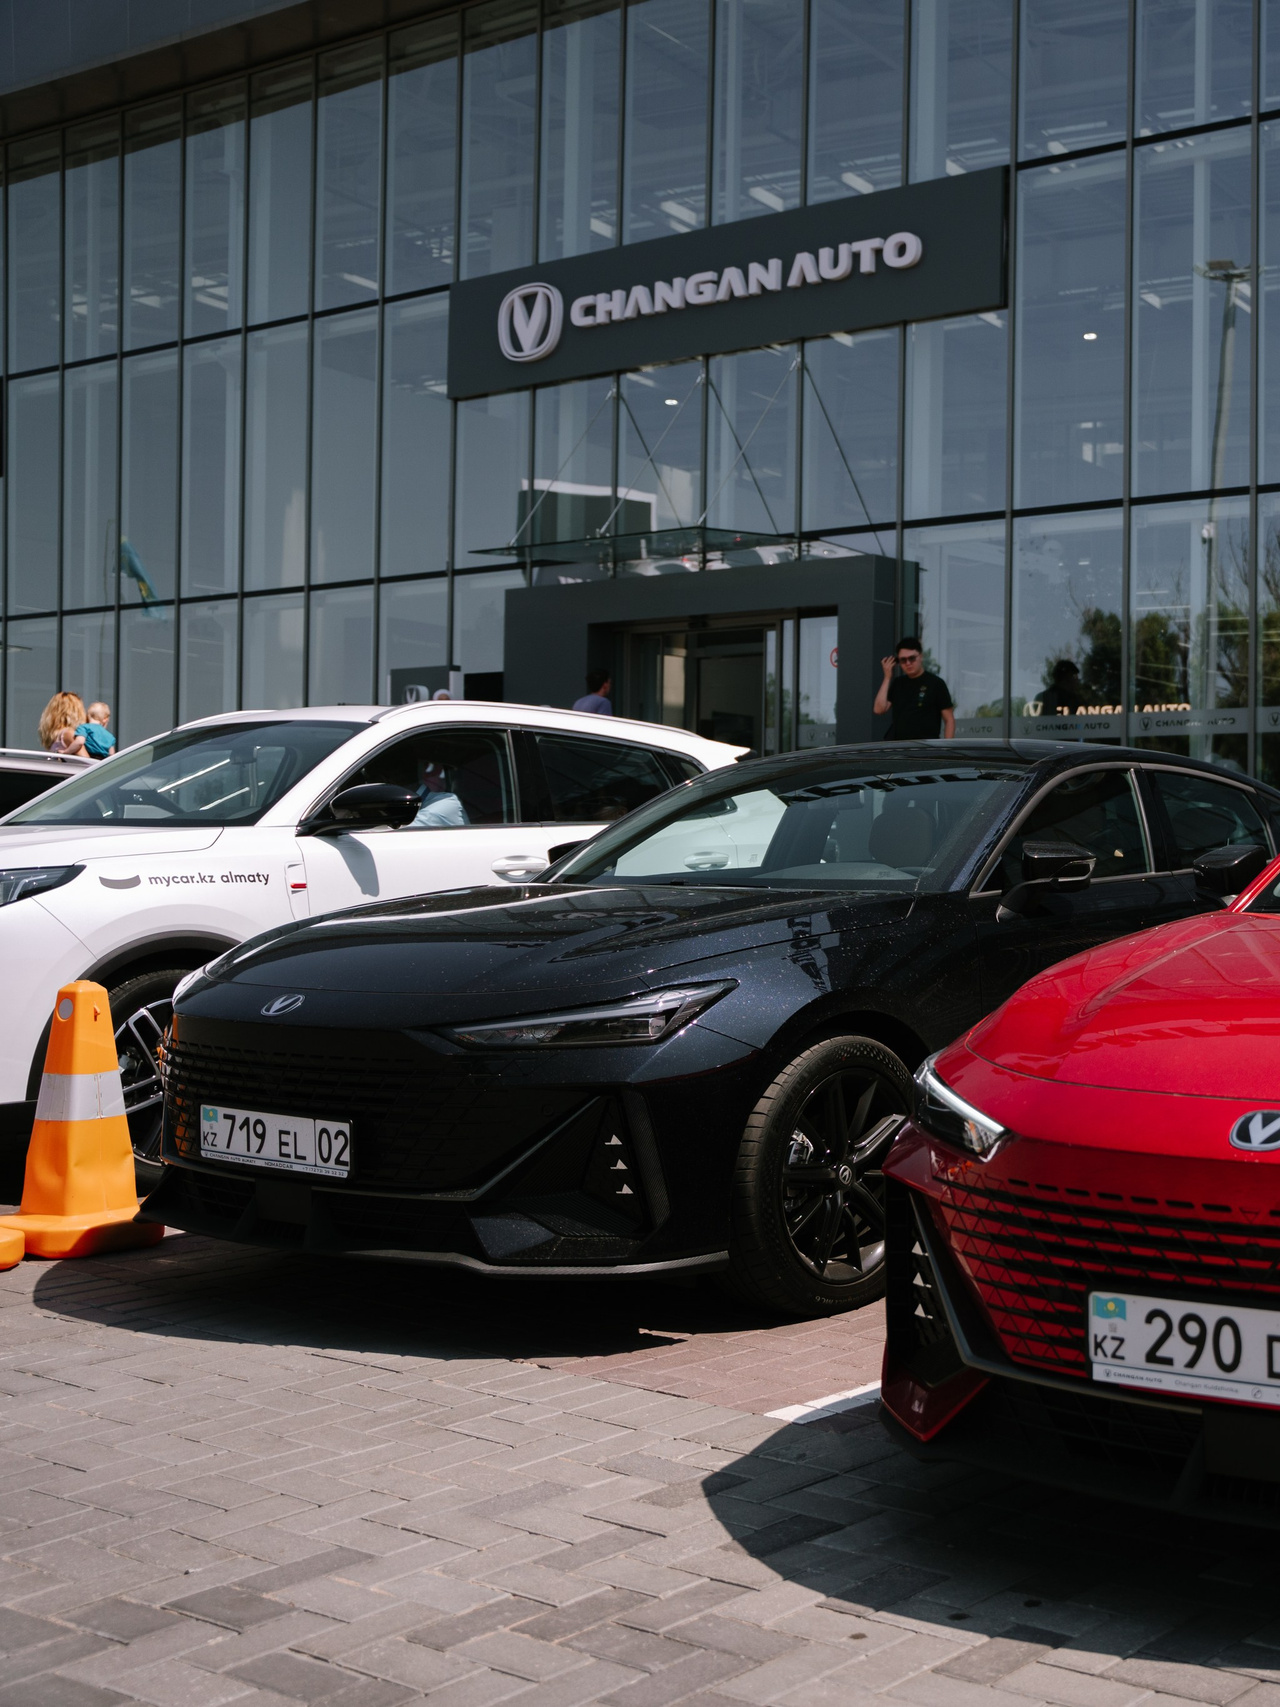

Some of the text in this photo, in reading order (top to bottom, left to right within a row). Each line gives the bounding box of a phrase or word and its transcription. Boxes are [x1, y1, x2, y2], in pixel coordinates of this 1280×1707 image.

[569, 257, 782, 328] CHANGAN
[787, 231, 922, 288] AUTO
[1083, 722, 1110, 730] AUTO
[148, 871, 270, 887] mycar.kz almaty
[202, 1131, 217, 1147] KZ
[223, 1113, 349, 1167] 719 EL 02
[1093, 1333, 1126, 1361] KZ
[1144, 1308, 1243, 1374] 290
[1113, 1371, 1163, 1384] CHANGAN AUTO
